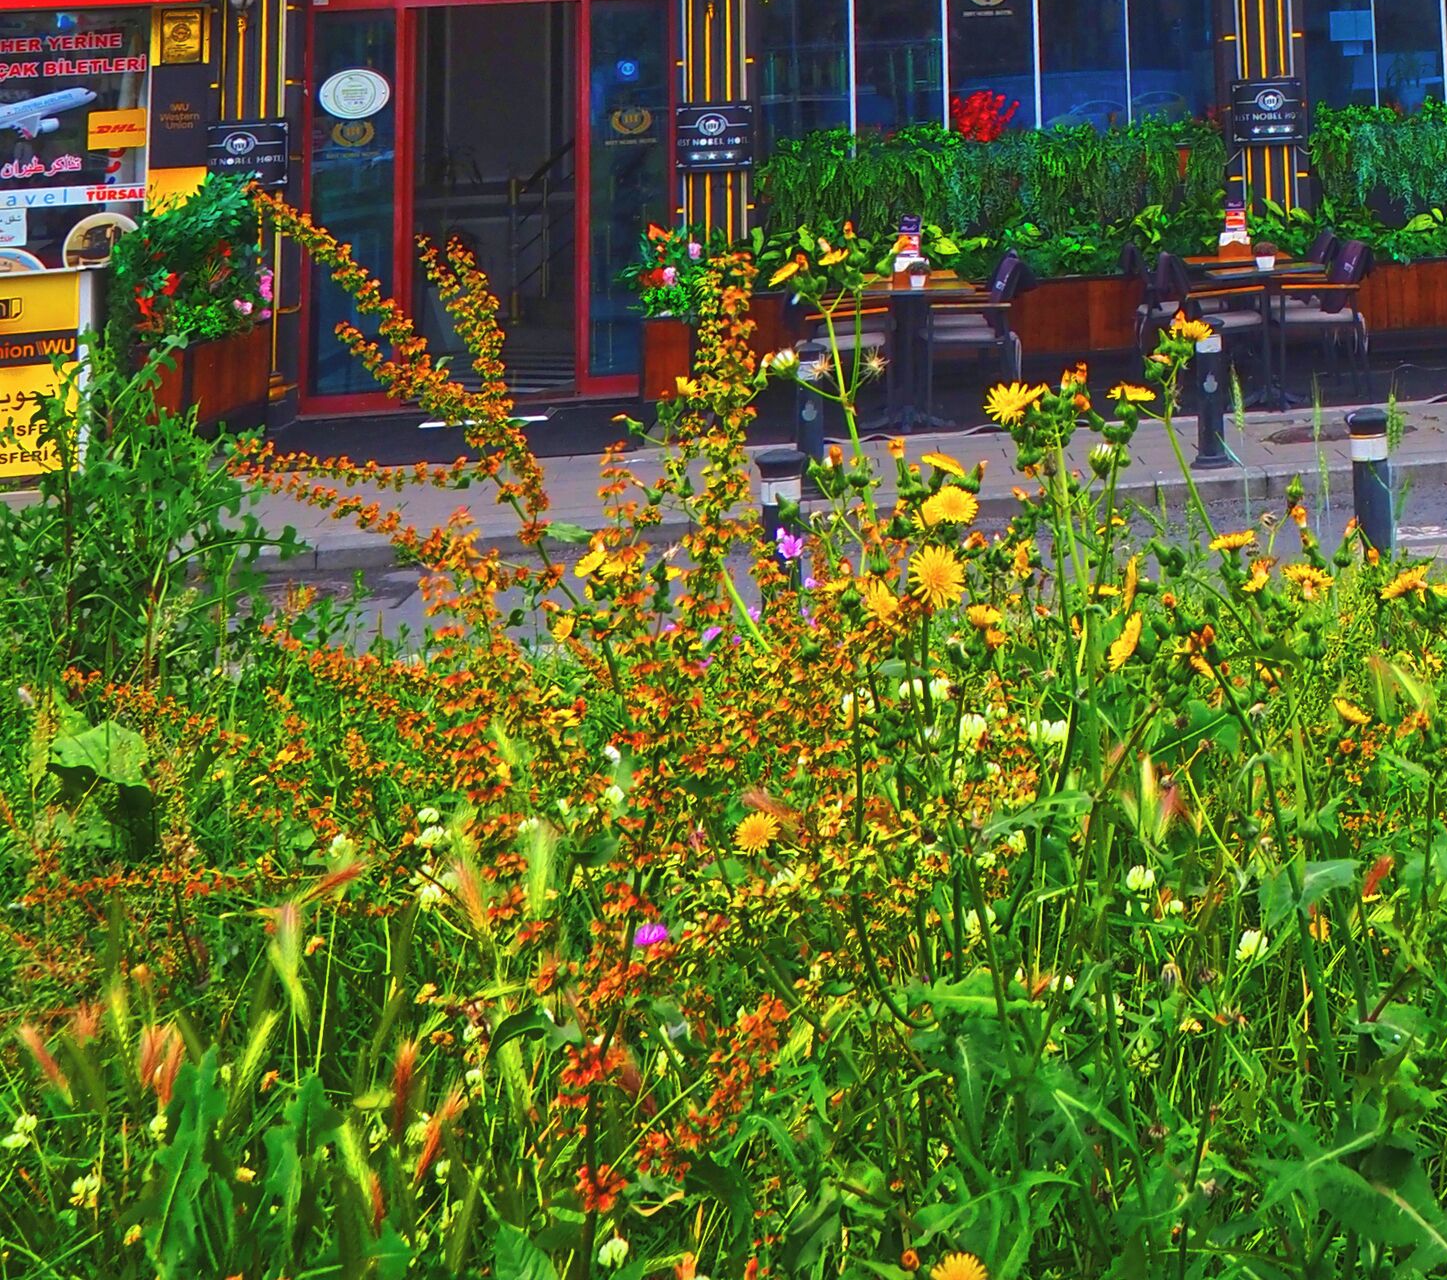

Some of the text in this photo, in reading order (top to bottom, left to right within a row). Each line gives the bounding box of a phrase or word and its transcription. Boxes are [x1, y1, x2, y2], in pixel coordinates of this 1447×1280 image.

[0, 32, 122, 54] HER YERİNE
[44, 54, 147, 77] BİLETLERİ
[96, 123, 138, 134] DHL
[692, 137, 724, 146] NOBEL
[36, 337, 76, 355] WU
